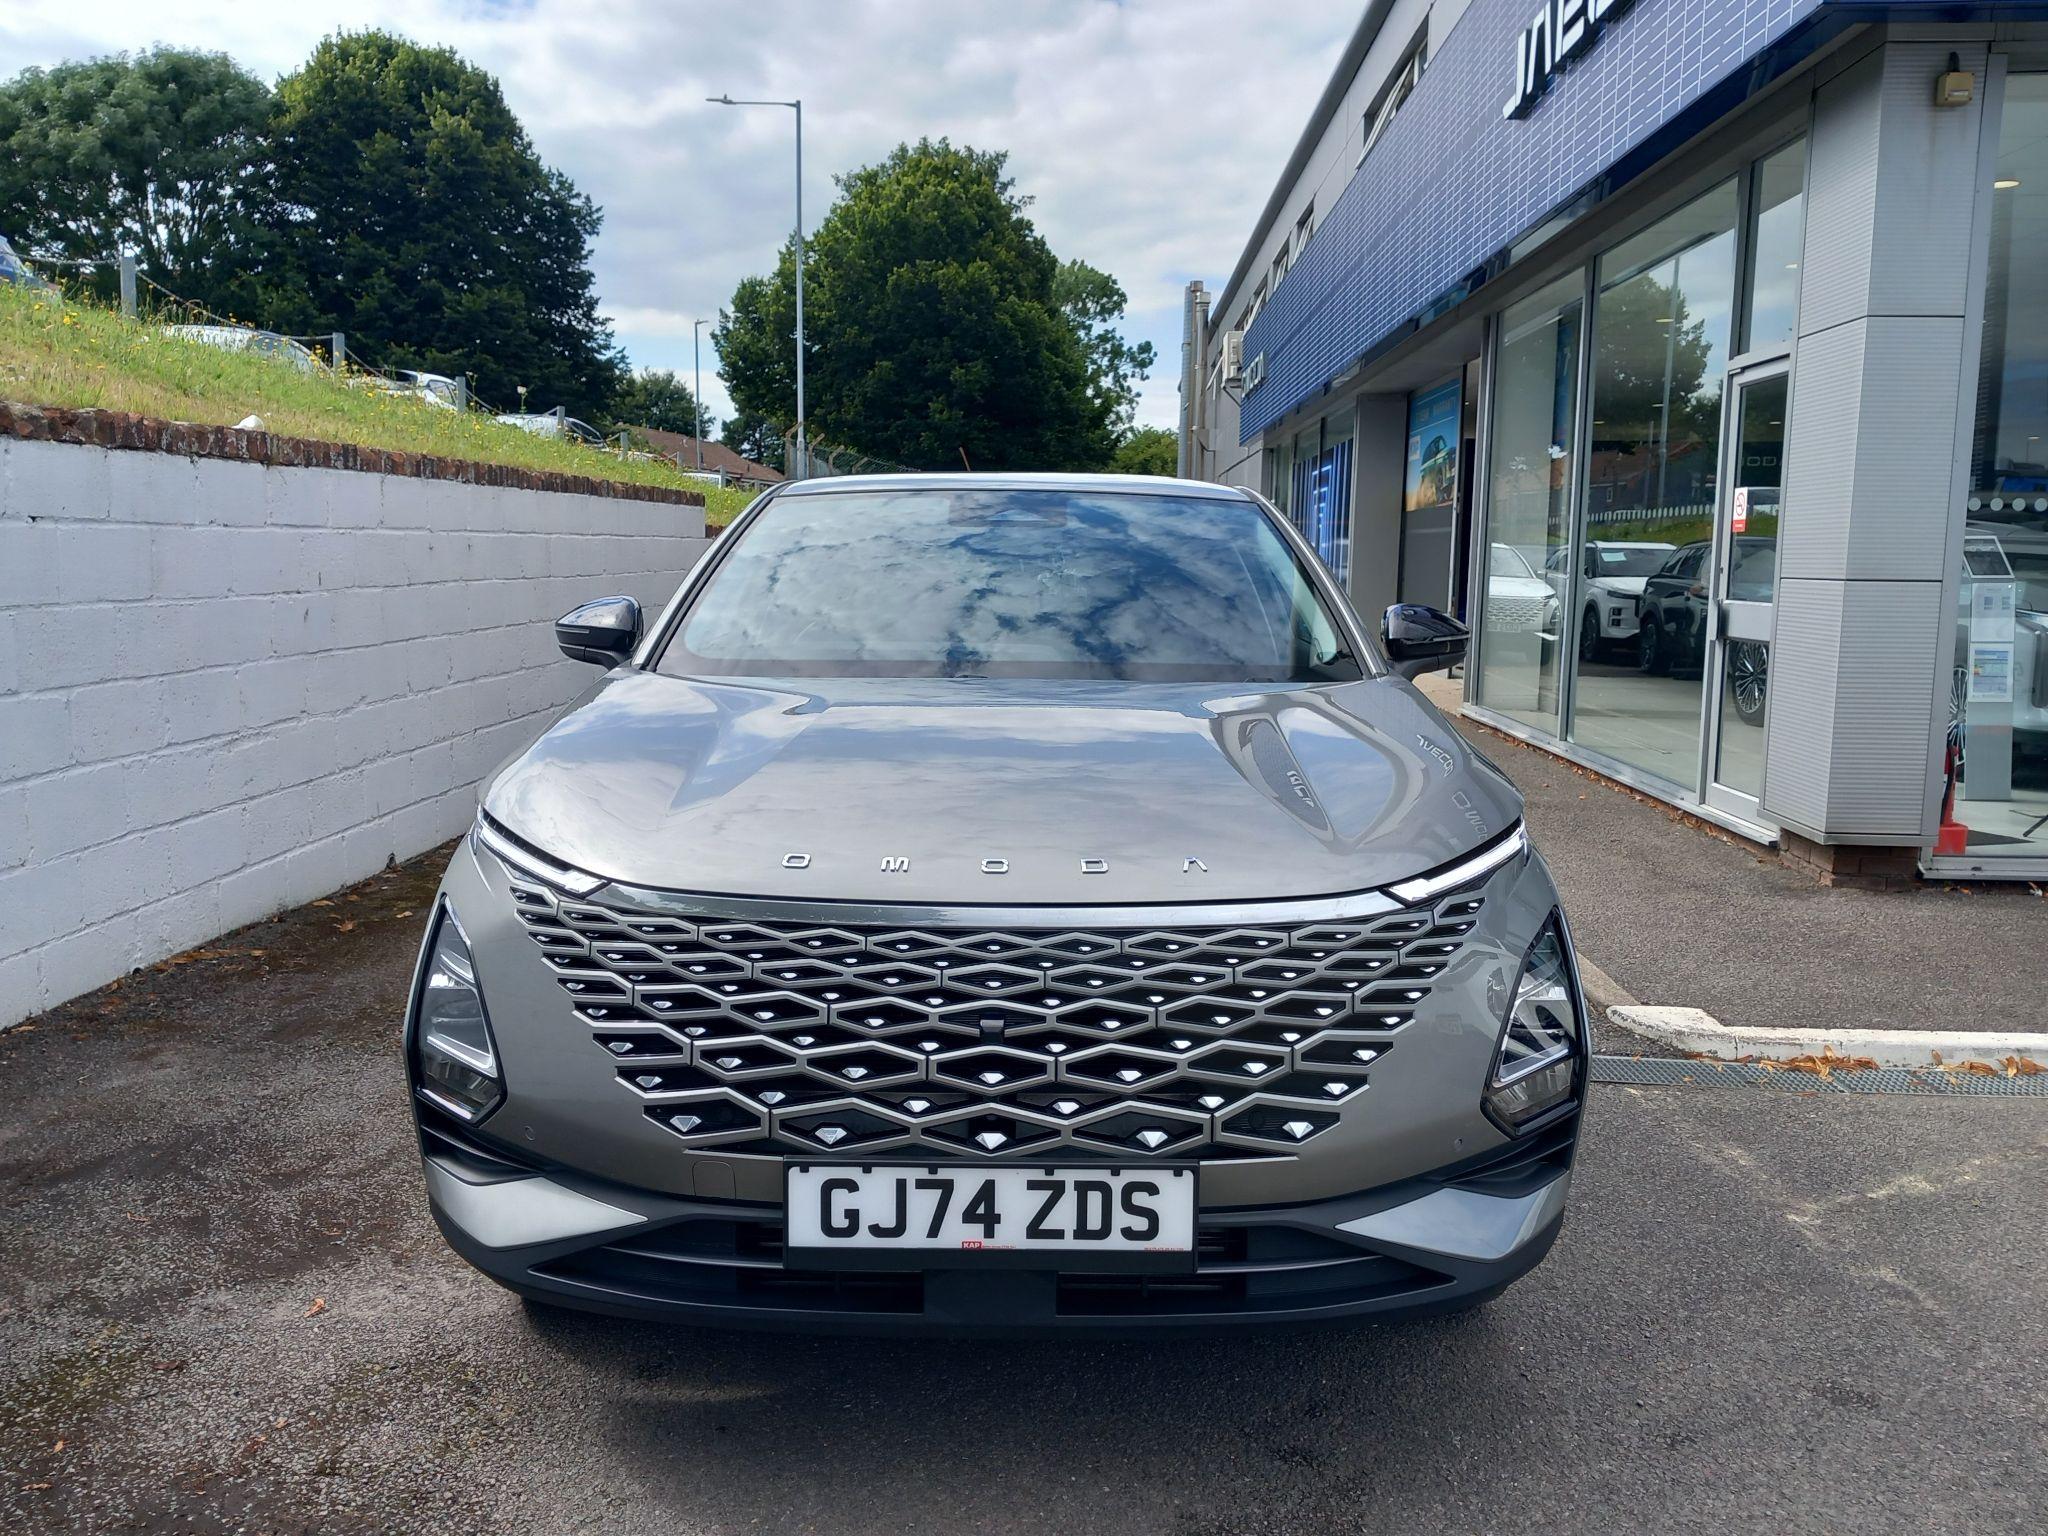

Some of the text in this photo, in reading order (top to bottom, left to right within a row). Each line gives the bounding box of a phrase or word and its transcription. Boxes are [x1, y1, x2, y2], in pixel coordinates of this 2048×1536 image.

[781, 853, 1208, 874] OMODA
[820, 1178, 1161, 1241] GJ74 ZDS
[962, 1241, 981, 1249] KAP
